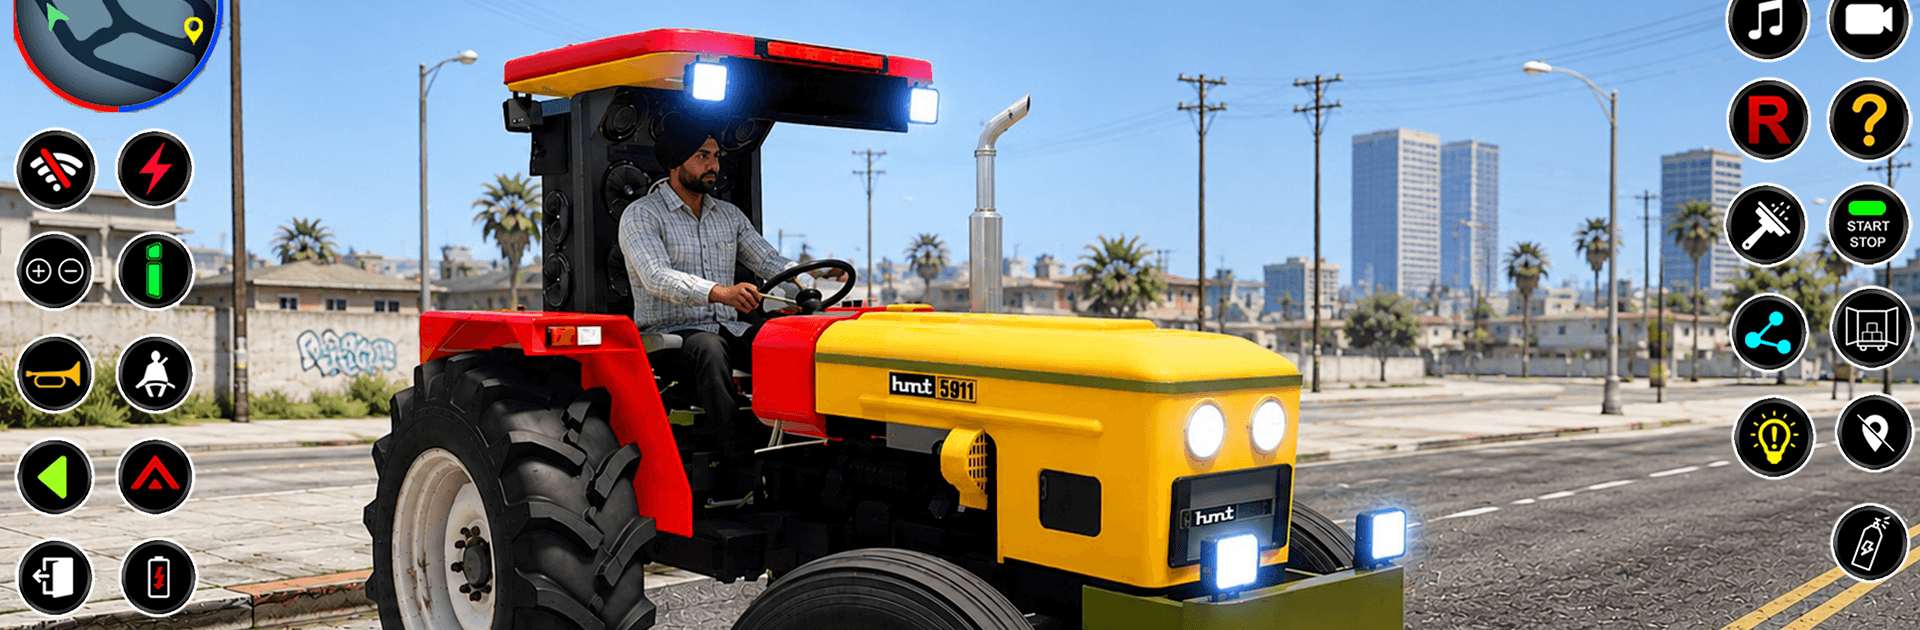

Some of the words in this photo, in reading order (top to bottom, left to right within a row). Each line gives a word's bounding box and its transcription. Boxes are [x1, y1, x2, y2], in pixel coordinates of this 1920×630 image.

[891, 375, 933, 395] hmt
[940, 379, 974, 400] 5911
[1195, 506, 1235, 526] hmt
